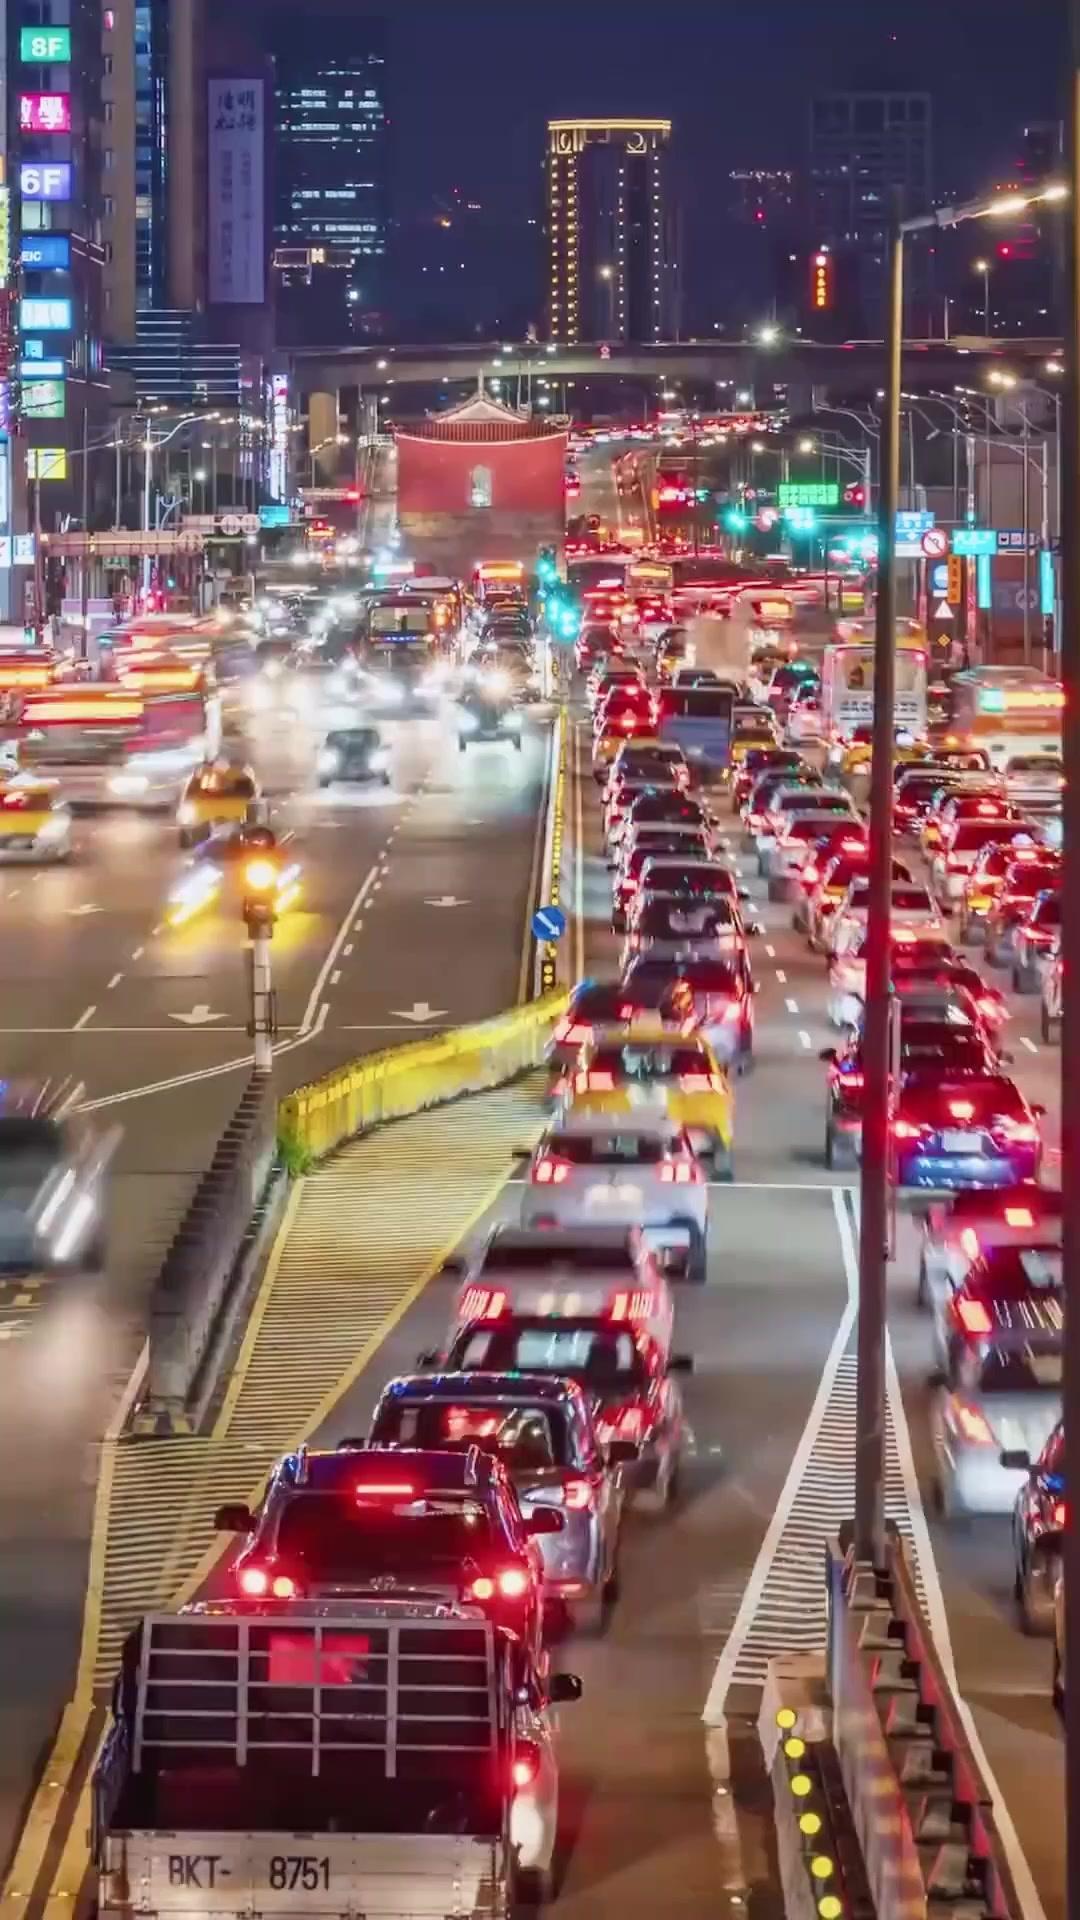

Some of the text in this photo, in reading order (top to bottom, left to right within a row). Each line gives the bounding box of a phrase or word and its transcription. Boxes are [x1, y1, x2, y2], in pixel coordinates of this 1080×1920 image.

[31, 36, 64, 57] 8F
[21, 168, 61, 194] 6F
[168, 1855, 330, 1891] BKT- 8751
